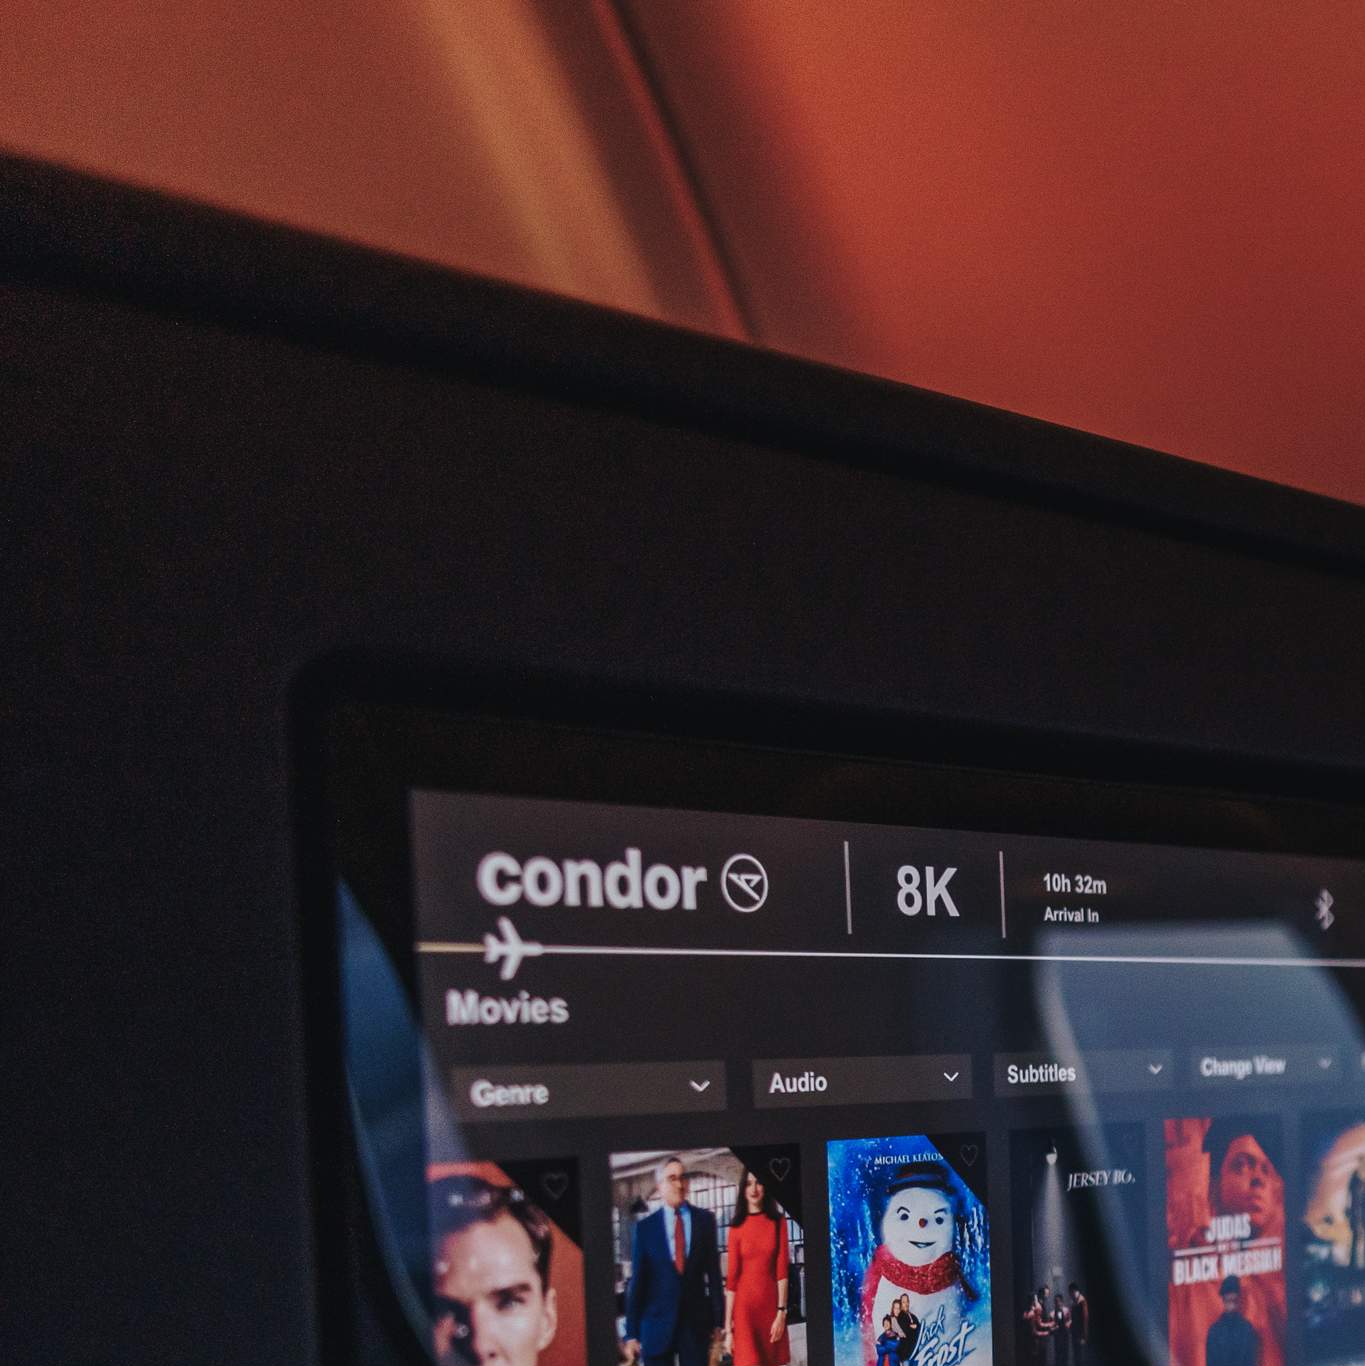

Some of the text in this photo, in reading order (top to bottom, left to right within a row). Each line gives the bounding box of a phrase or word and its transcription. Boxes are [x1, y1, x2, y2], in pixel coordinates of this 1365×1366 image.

[477, 846, 708, 911] condor
[896, 864, 961, 918] 8K
[1043, 873, 1107, 895] 10h 32m
[1044, 906, 1100, 924] Arrival In
[445, 990, 571, 1026] Movies
[1007, 1063, 1077, 1084] Subtitles
[1200, 1055, 1287, 1081] Change View
[470, 1078, 549, 1107] Genre
[769, 1071, 828, 1095] Audio
[874, 1155, 910, 1166] MICHAEL
[1067, 1170, 1110, 1191] JERSEY
[1205, 1212, 1251, 1243] JUDAS
[1173, 1255, 1220, 1286] BLACK
